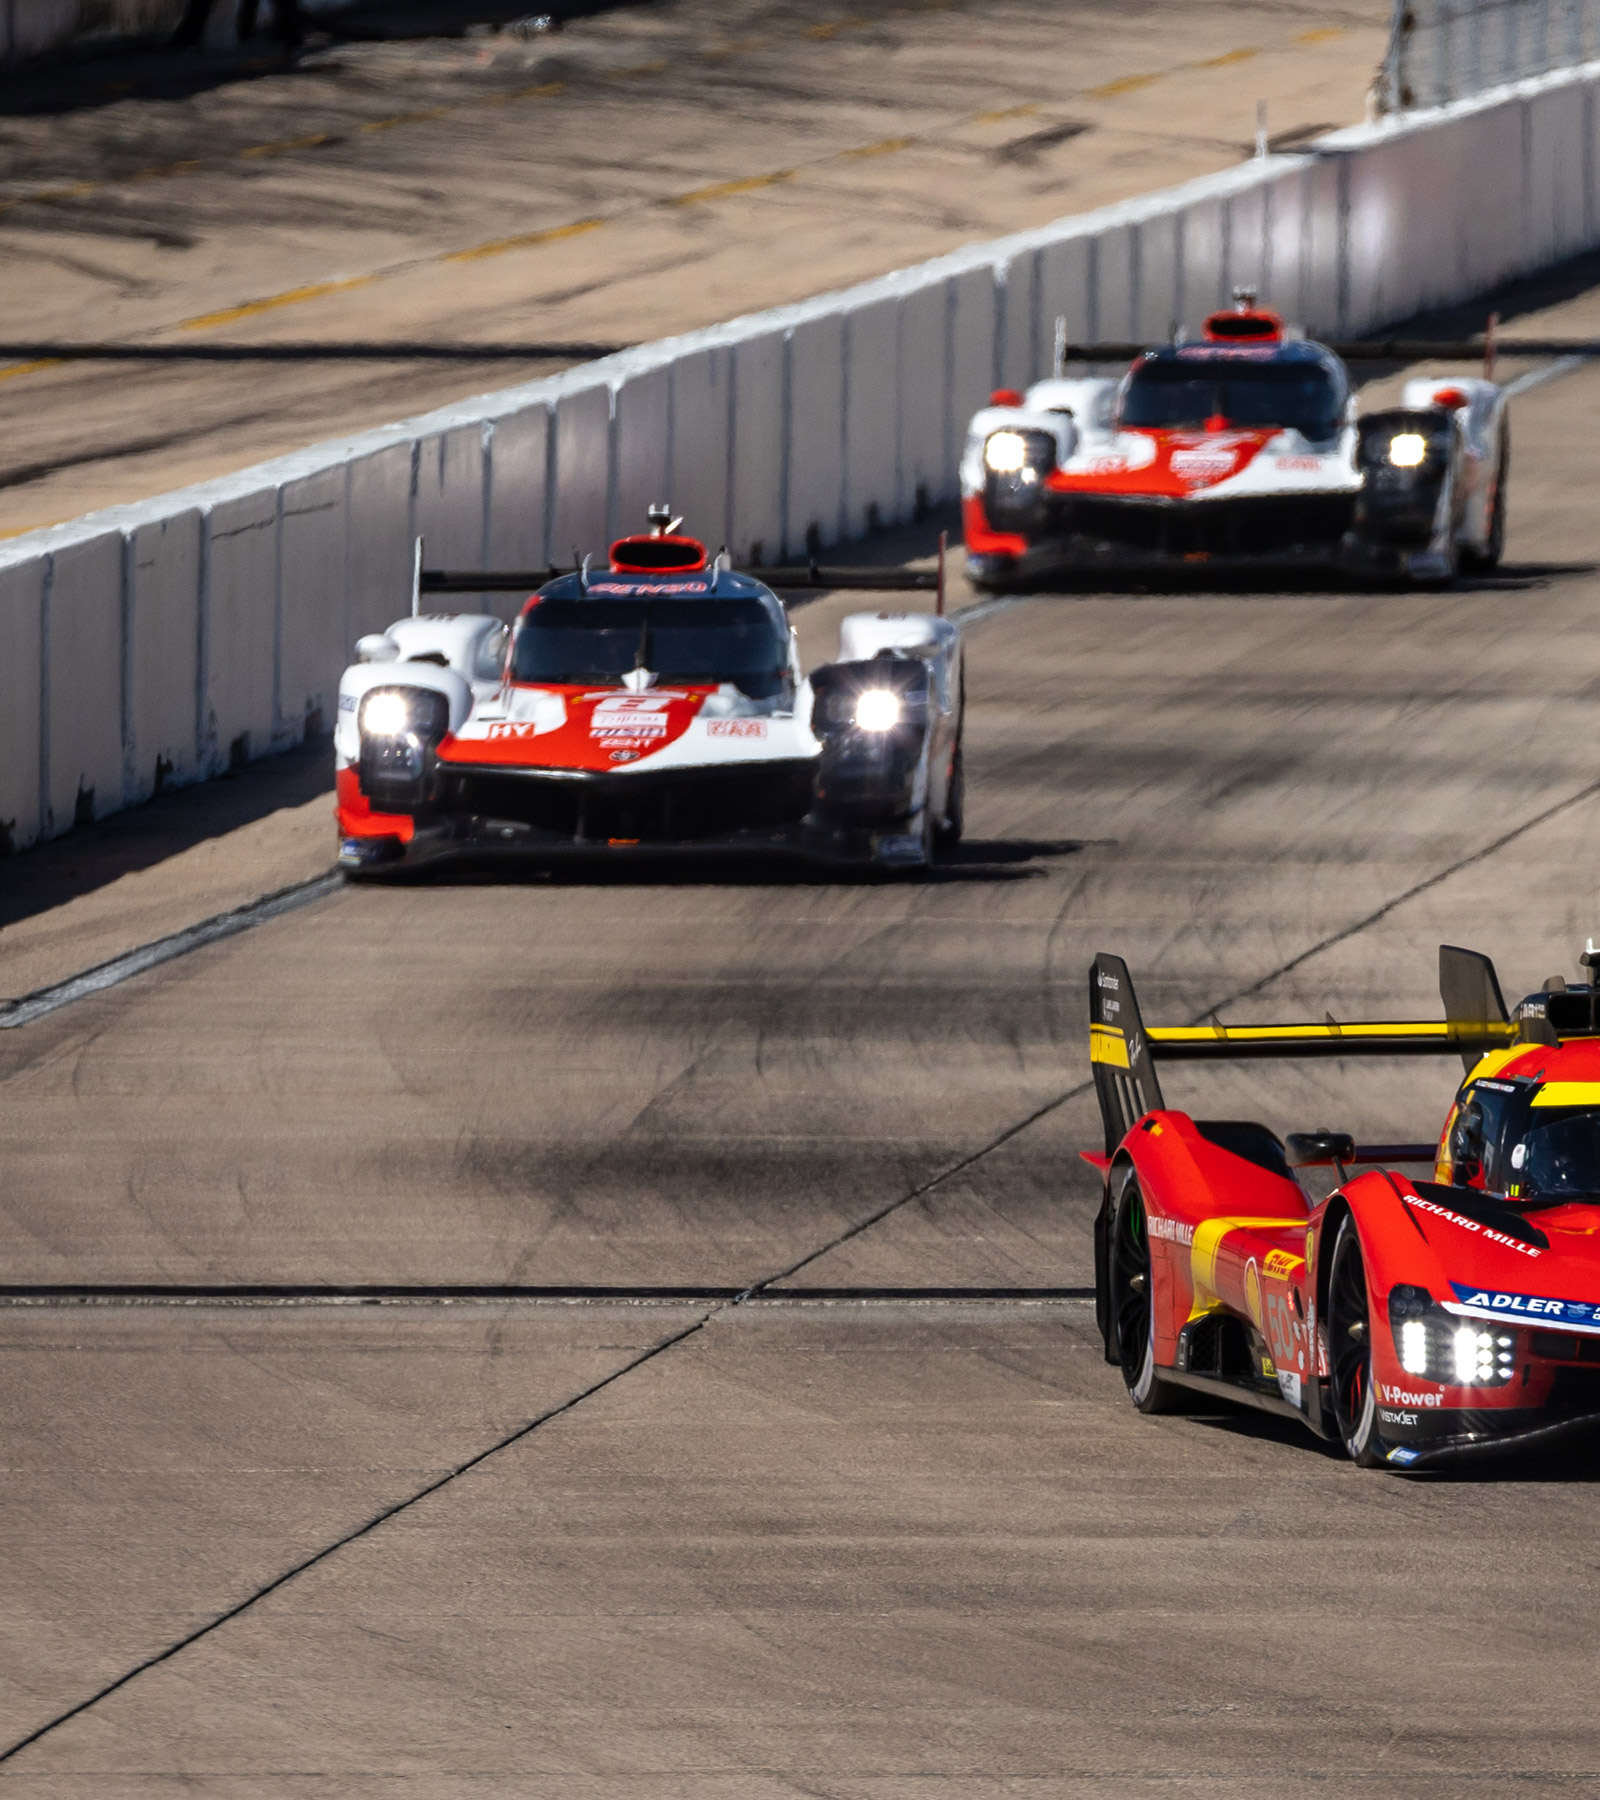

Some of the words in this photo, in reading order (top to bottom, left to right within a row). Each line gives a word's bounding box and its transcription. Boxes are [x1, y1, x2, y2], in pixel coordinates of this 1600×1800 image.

[588, 582, 707, 595] DENSO
[491, 725, 531, 738] HY
[1148, 1215, 1175, 1241] RICHARD
[1176, 1222, 1193, 1246] MILLE
[1403, 1195, 1481, 1232] RICHARD
[1482, 1228, 1542, 1258] MILLE
[1465, 1293, 1564, 1315] ADLER
[1267, 1294, 1294, 1361] 50
[1381, 1384, 1444, 1407] V-Power
